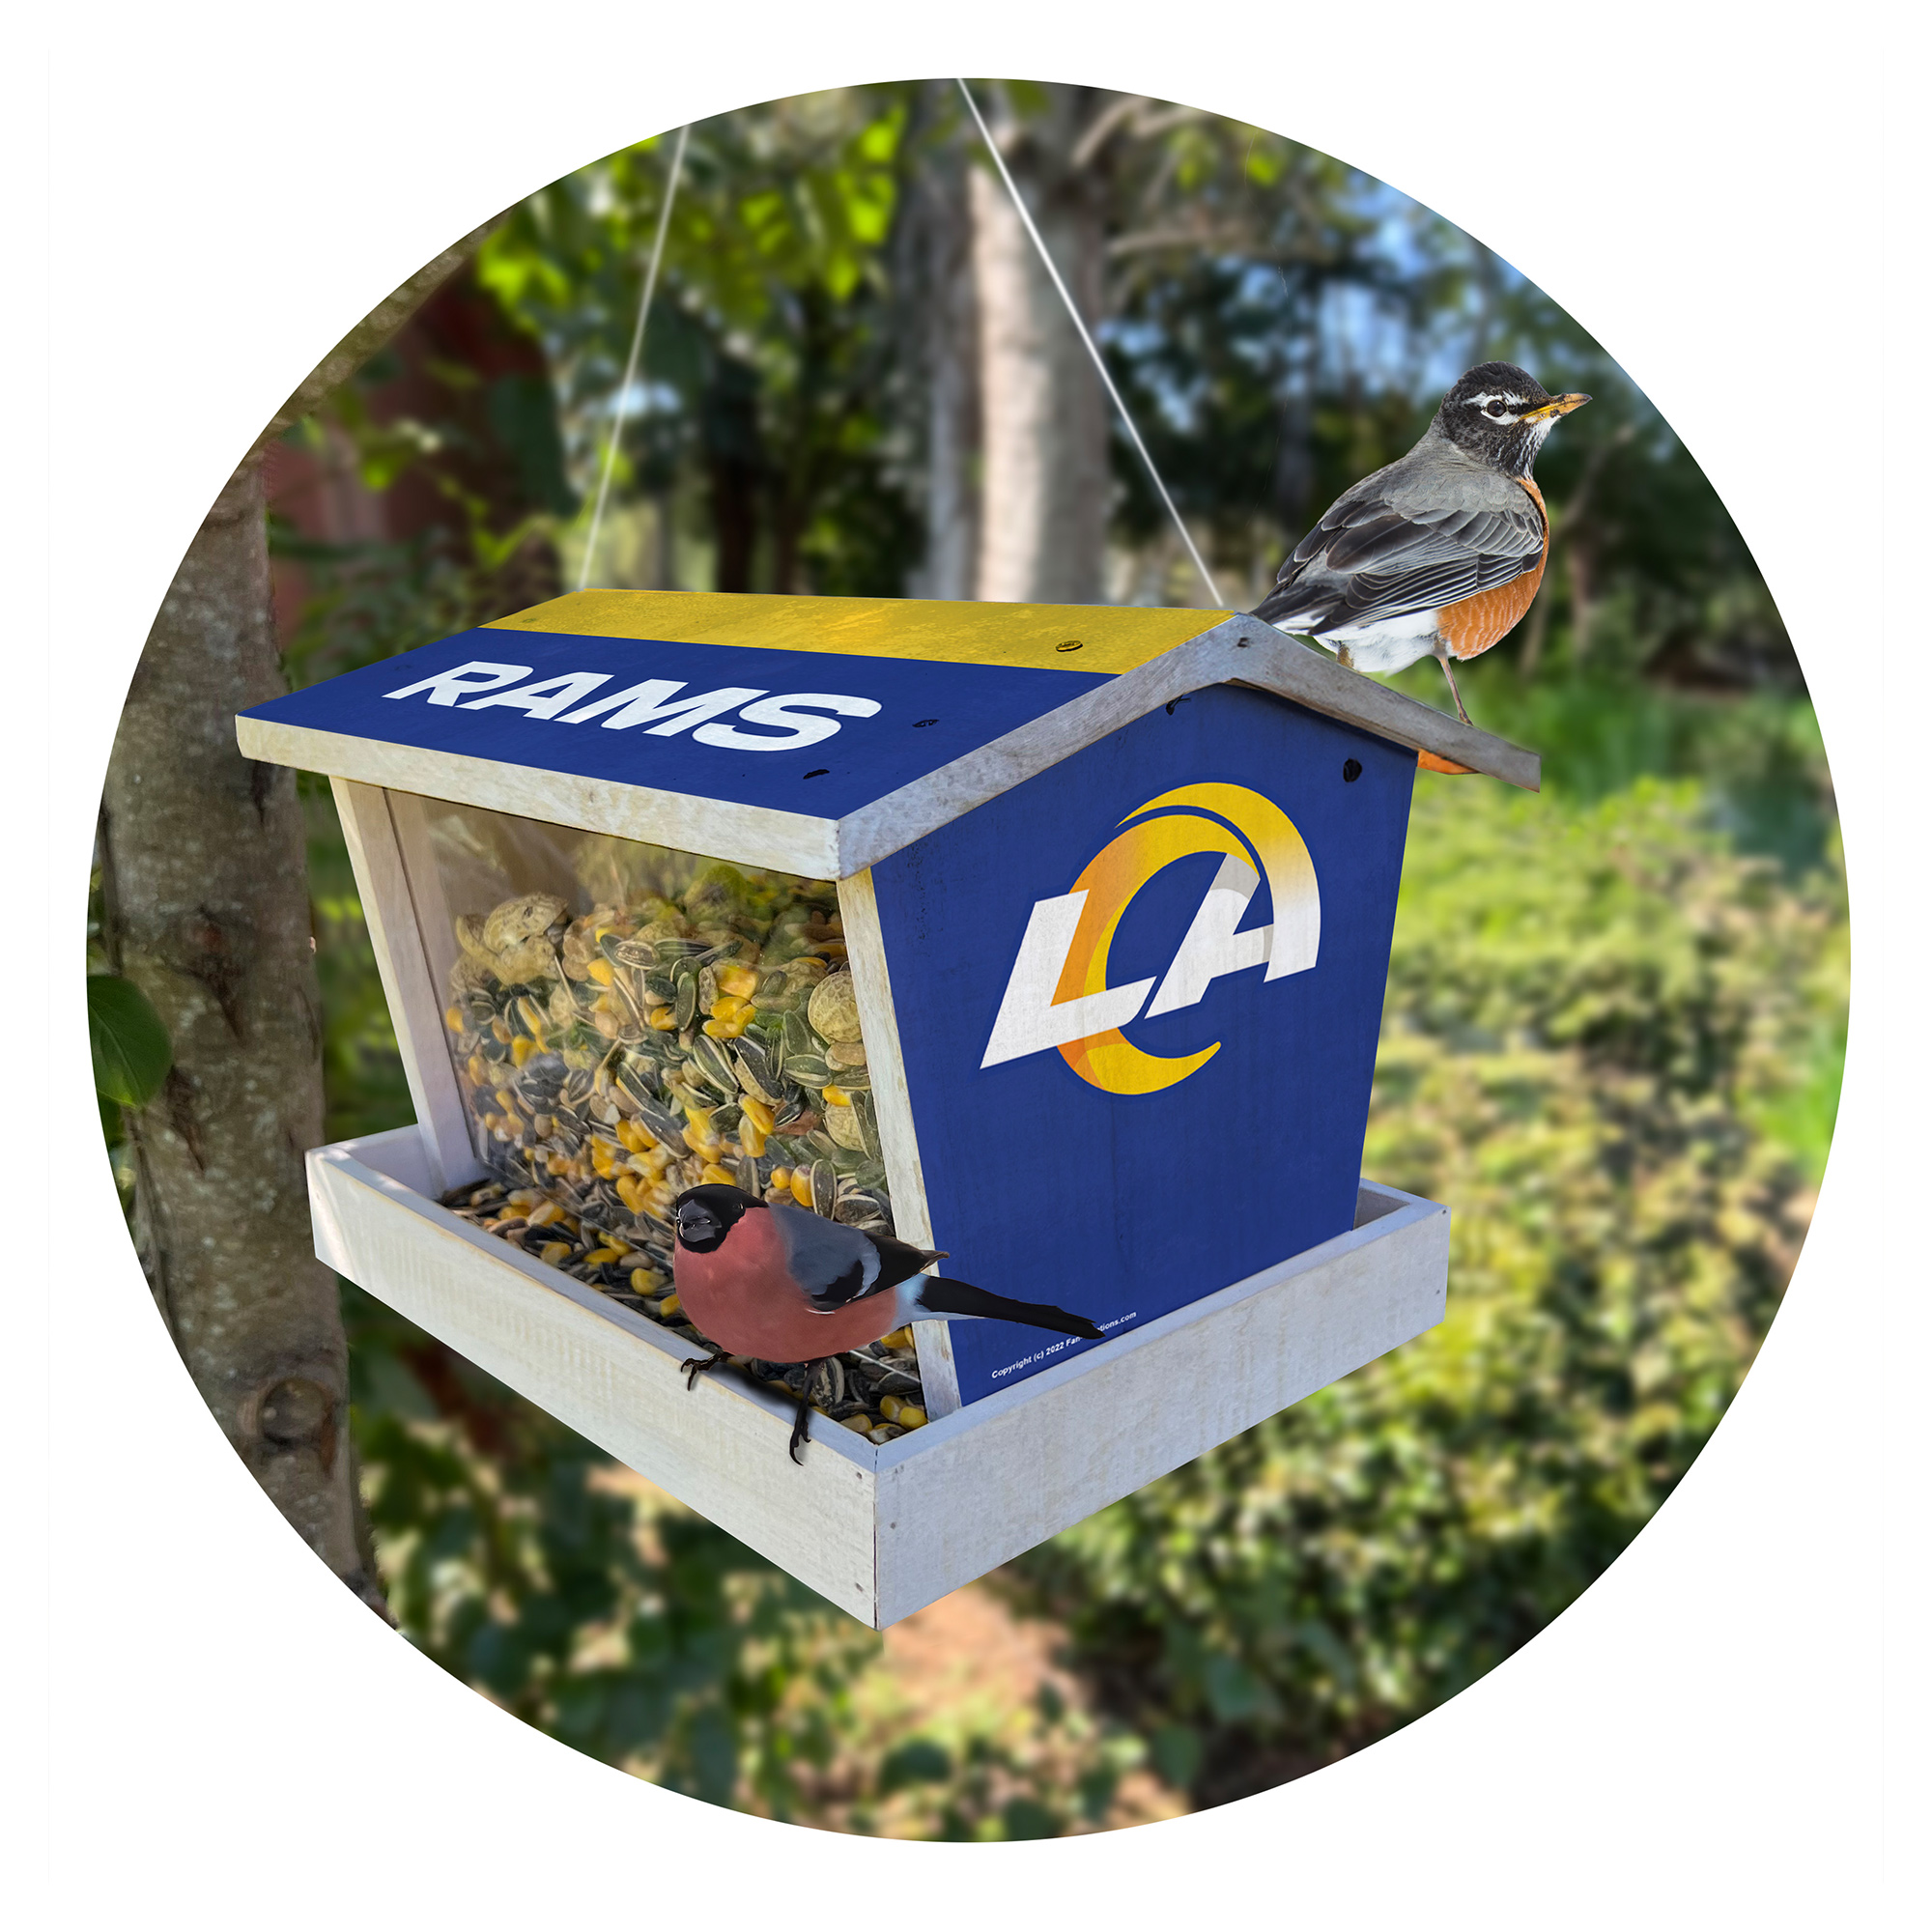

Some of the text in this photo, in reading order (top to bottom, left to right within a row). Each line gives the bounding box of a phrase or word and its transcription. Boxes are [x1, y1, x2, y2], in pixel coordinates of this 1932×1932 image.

[382, 661, 883, 752] RAMS
[980, 782, 1321, 1070] LA
[991, 1311, 1137, 1379] Copyright (c) 2022 Fantions.com
